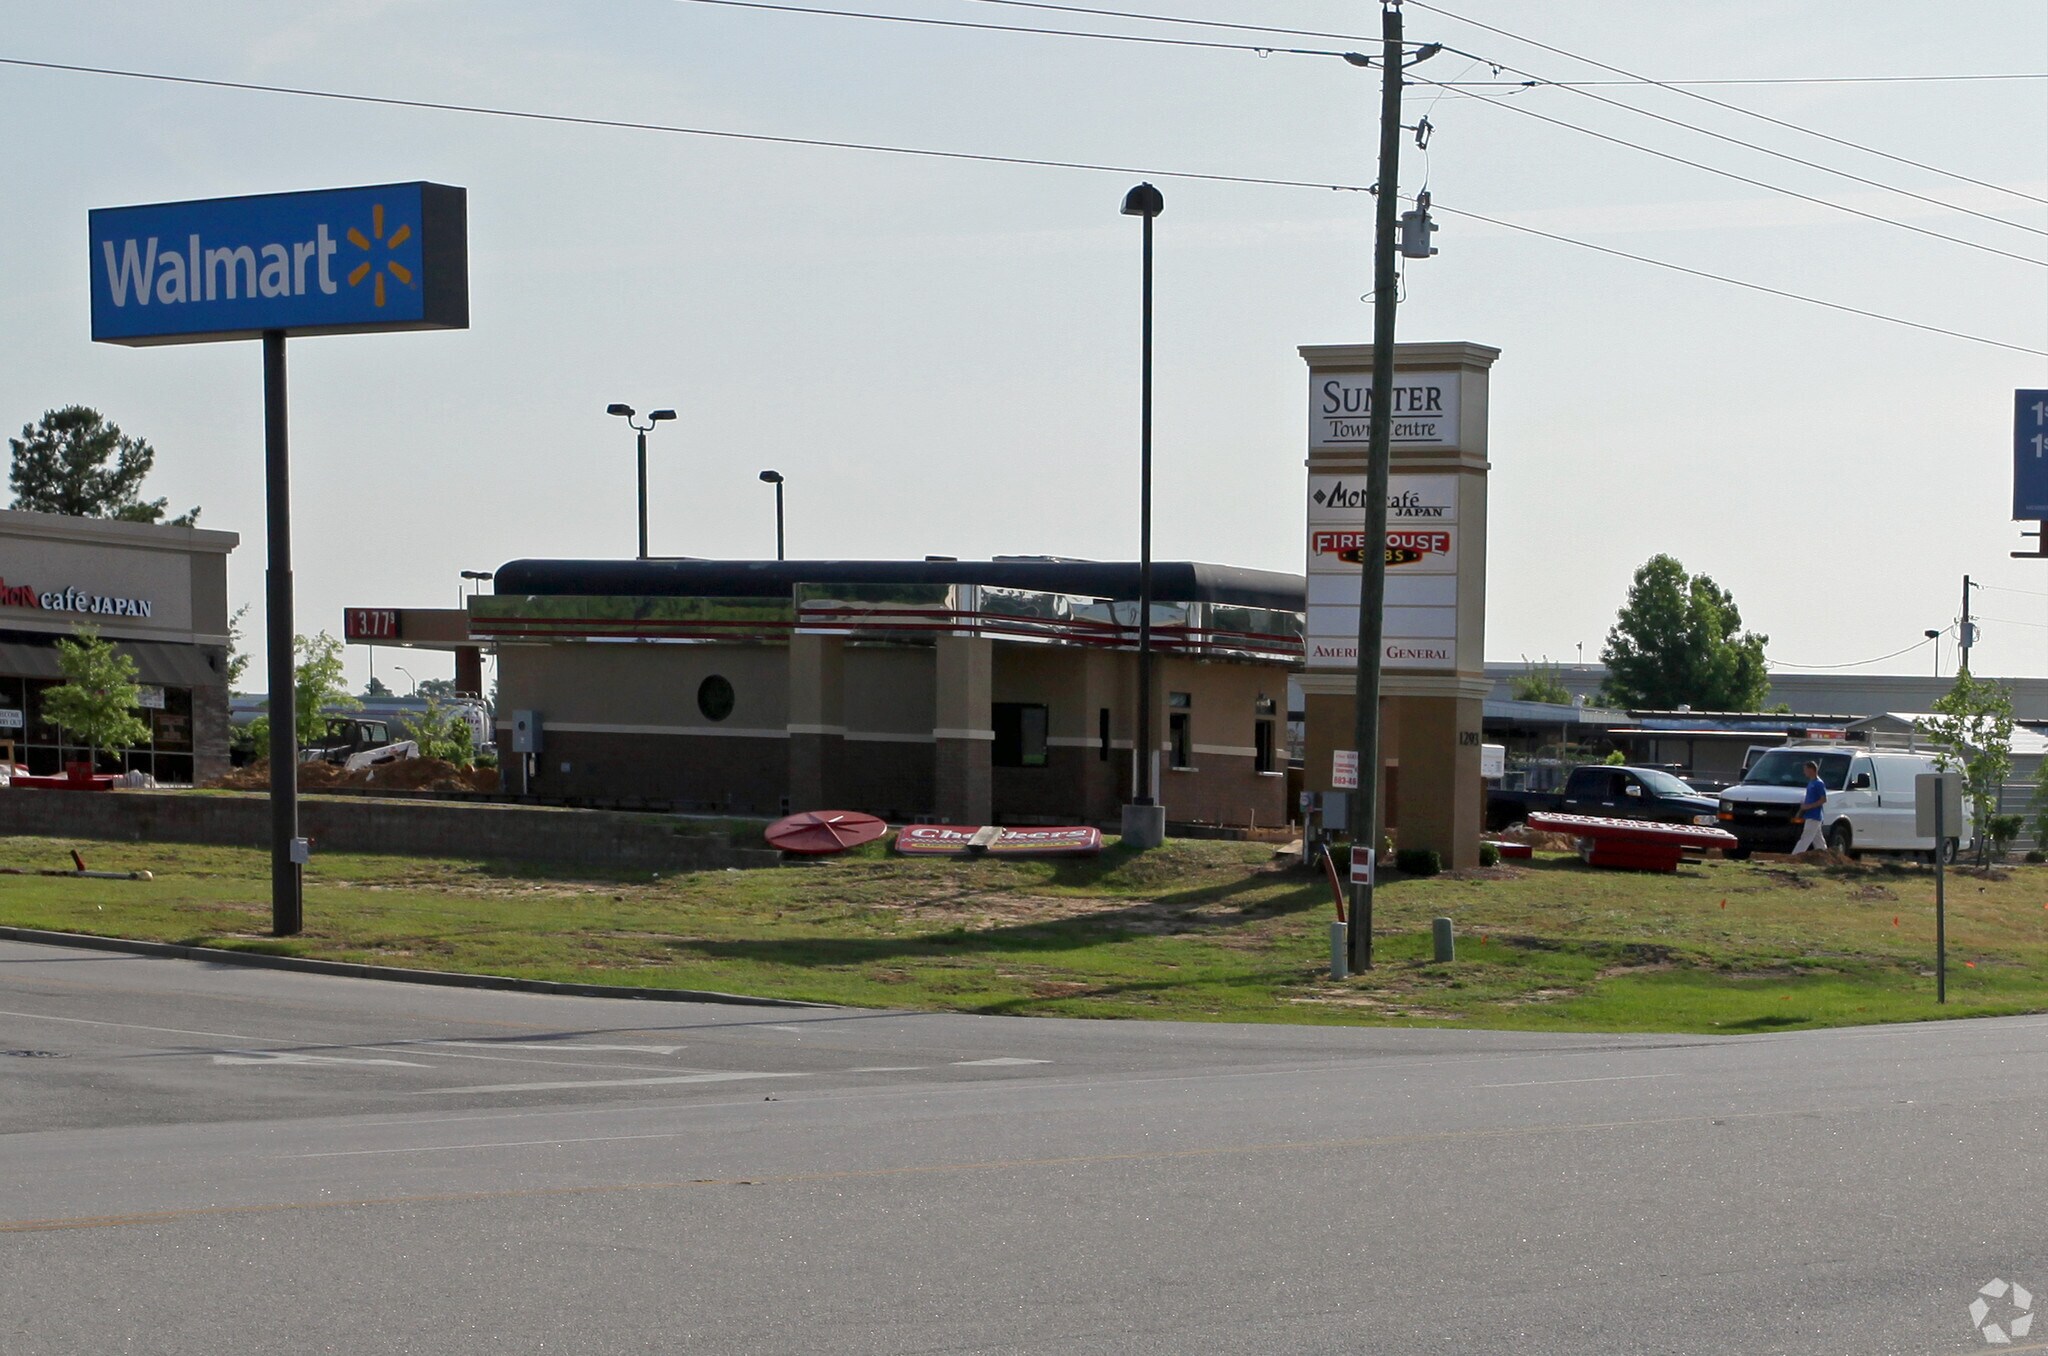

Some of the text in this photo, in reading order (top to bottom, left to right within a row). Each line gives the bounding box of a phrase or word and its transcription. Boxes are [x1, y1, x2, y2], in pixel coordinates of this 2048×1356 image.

[103, 224, 337, 307] Walmart
[1391, 420, 1436, 436] entre
[1395, 508, 1443, 517] JAPAN
[1316, 534, 1446, 556] FIREOUSE
[1358, 550, 1404, 562] SBS
[40, 585, 87, 612] café
[90, 595, 151, 617] JAPAN
[1386, 645, 1450, 660] GENERAL
[1459, 731, 1479, 746] 1293
